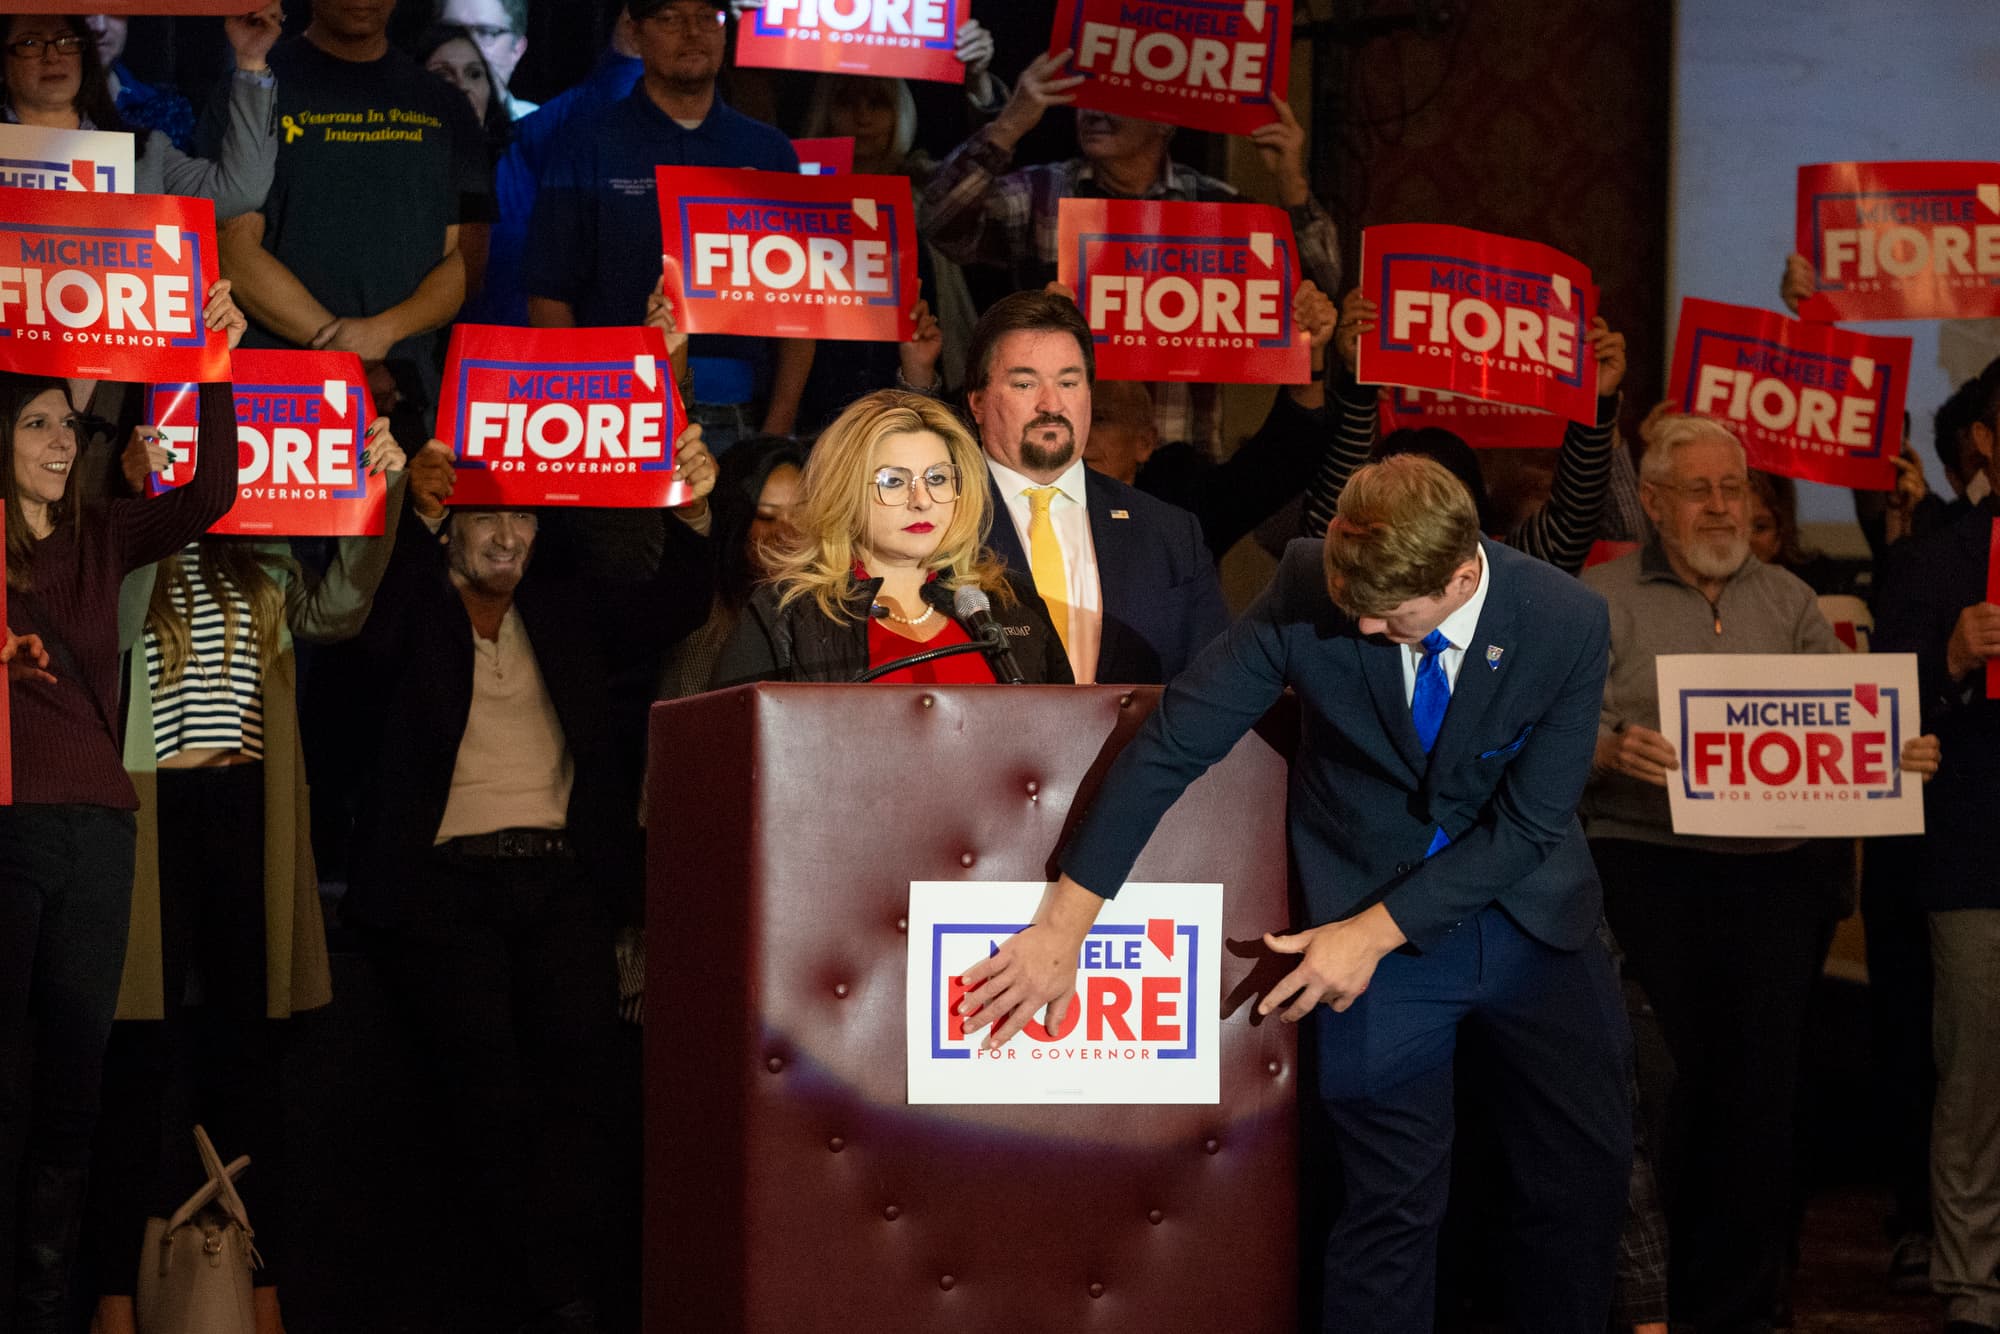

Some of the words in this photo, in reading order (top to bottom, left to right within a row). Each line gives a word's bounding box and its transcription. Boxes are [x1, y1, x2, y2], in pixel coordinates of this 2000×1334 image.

[1120, 4, 1240, 37] MICHELE
[787, 28, 821, 40] FOR
[828, 31, 921, 48] GOVERNOR
[1077, 21, 1267, 93] FIORE
[1098, 73, 1131, 88] FOR
[1142, 81, 1236, 104] GOVERNOR
[299, 110, 363, 124] Veterans
[368, 109, 384, 123] In
[324, 127, 424, 142] International
[727, 209, 853, 235] MICHELE
[1855, 200, 1975, 225] MICHELE
[20, 237, 153, 269] MICHELE
[694, 233, 889, 292] FIORE
[1125, 247, 1248, 274] MICHELE
[1824, 224, 2000, 280] FIORE
[721, 290, 755, 301] FOR
[765, 292, 864, 306] GOVERNOR
[1431, 266, 1550, 309] MICHELE
[1089, 275, 1281, 334] FIORE
[17, 329, 51, 341] FOR
[63, 332, 167, 348] GOVERNOR
[1113, 335, 1147, 346] FOR
[1157, 336, 1255, 348] GOVERNOR
[1393, 289, 1576, 373] FIORE
[1418, 345, 1453, 358] FOR
[1461, 352, 1553, 378] GOVERNOR
[1737, 348, 1848, 391] MICHELE
[509, 374, 633, 399] MICHELE
[1427, 405, 1456, 416] FOR
[1695, 364, 1876, 447] FIORE
[467, 401, 663, 459] FIORE
[490, 460, 526, 472] FOR
[537, 461, 637, 473] GOVERNOR
[1003, 625, 1031, 637] TRUMP
[1726, 701, 1850, 726] MICHELE
[1694, 730, 1888, 786] FIORE
[1719, 790, 1751, 801] FOR
[1762, 790, 1862, 801] GOVERNOR
[977, 1048, 1016, 1060] FOR
[1032, 1048, 1151, 1060] GOVERNOR
